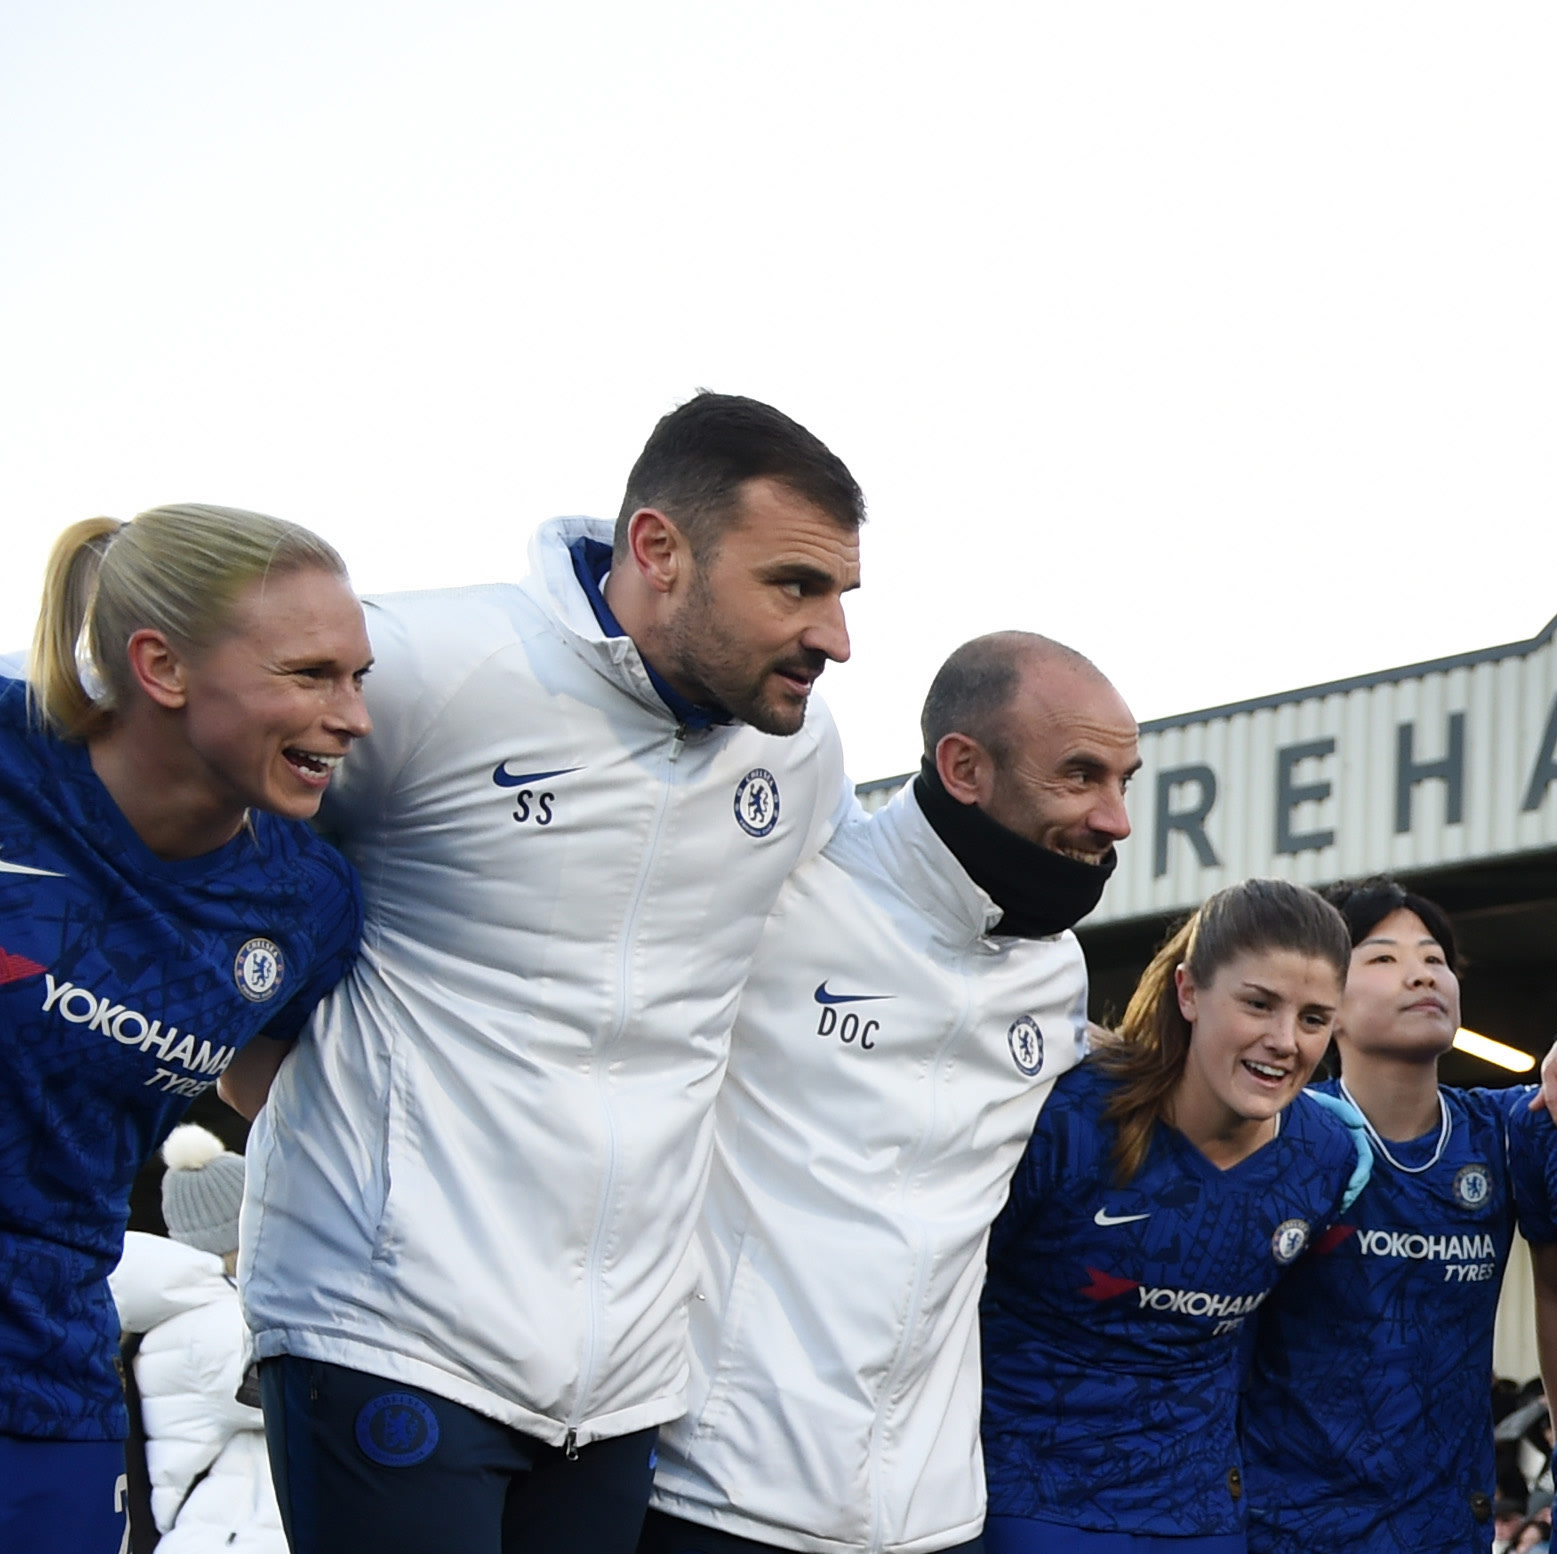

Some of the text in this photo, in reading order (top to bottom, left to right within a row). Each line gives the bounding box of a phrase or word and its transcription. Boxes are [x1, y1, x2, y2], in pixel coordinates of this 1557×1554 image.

[744, 769, 774, 788] CHELSEA
[512, 789, 556, 826] SS
[245, 939, 279, 958] CHELSEA
[39, 973, 235, 1077] YOKOHAMA
[816, 1005, 881, 1050] DOC
[1356, 1229, 1496, 1261] YOKOHAMA
[1442, 1262, 1494, 1283] TYRES
